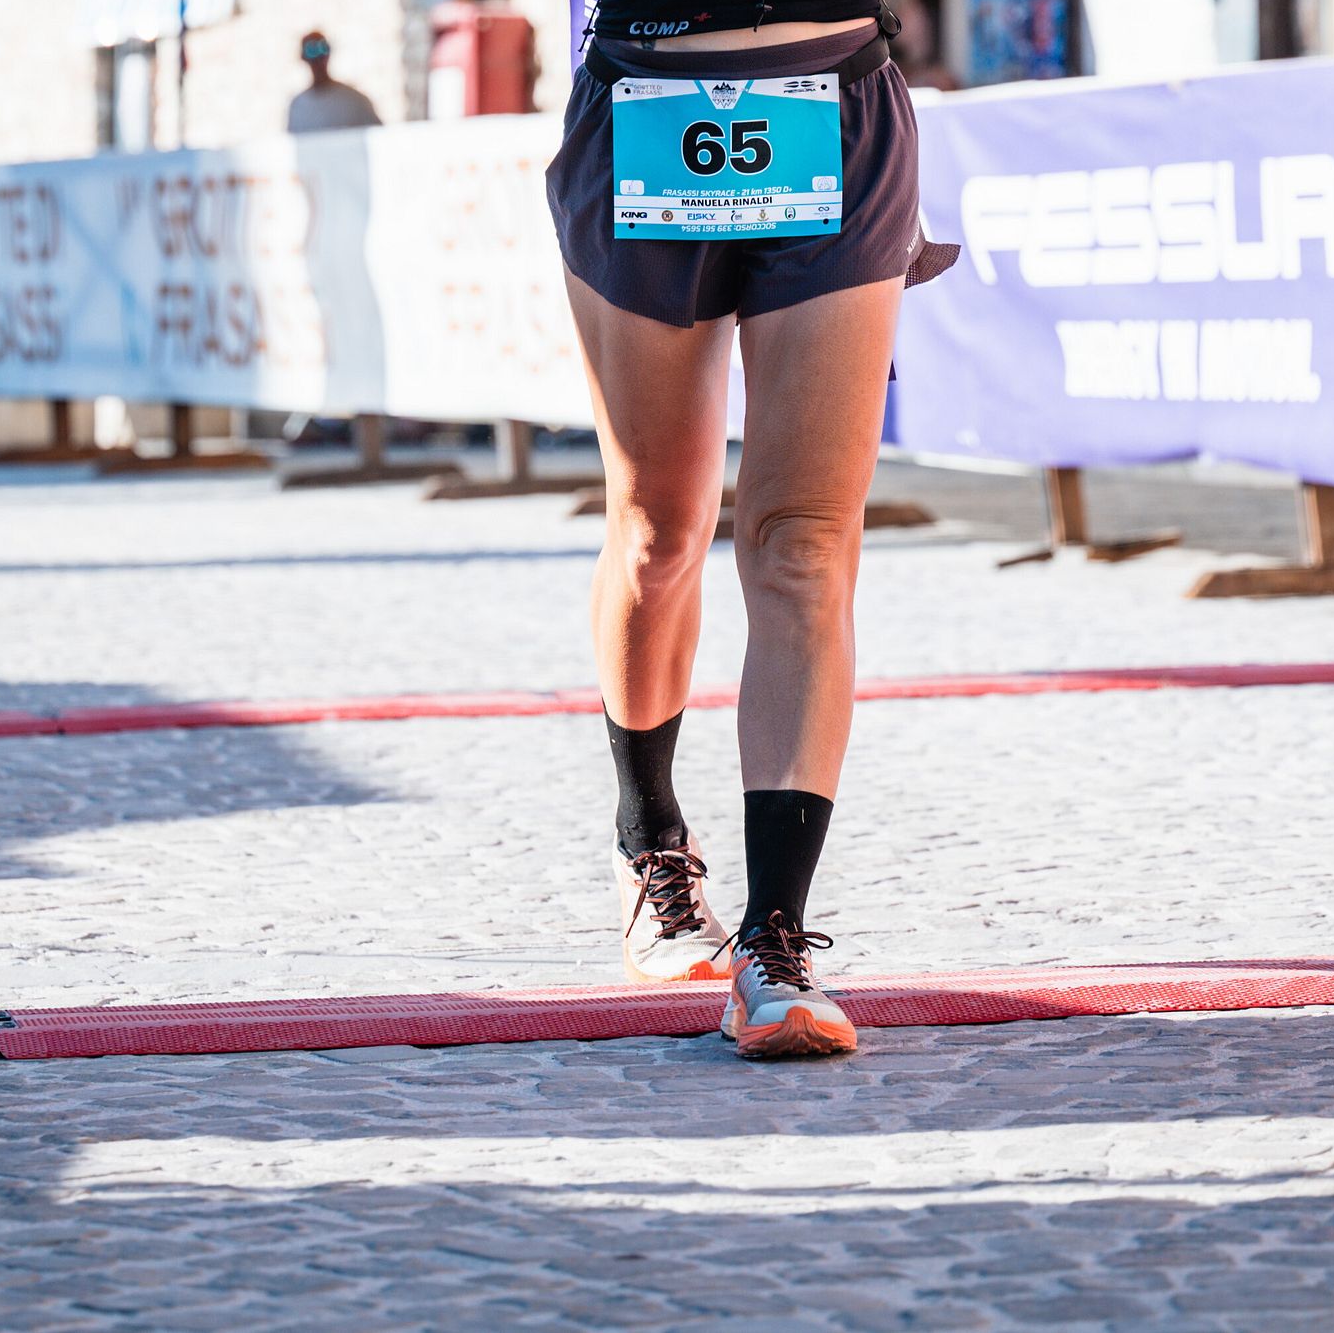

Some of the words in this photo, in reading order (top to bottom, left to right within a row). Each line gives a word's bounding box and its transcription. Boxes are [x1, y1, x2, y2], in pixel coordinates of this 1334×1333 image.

[629, 21, 689, 35] COMP
[681, 119, 773, 176] 65
[764, 186, 782, 194] 1350
[681, 199, 730, 207] MANUELA
[732, 196, 773, 206] RINALDI
[621, 211, 648, 219] KING
[717, 224, 732, 232] 339
